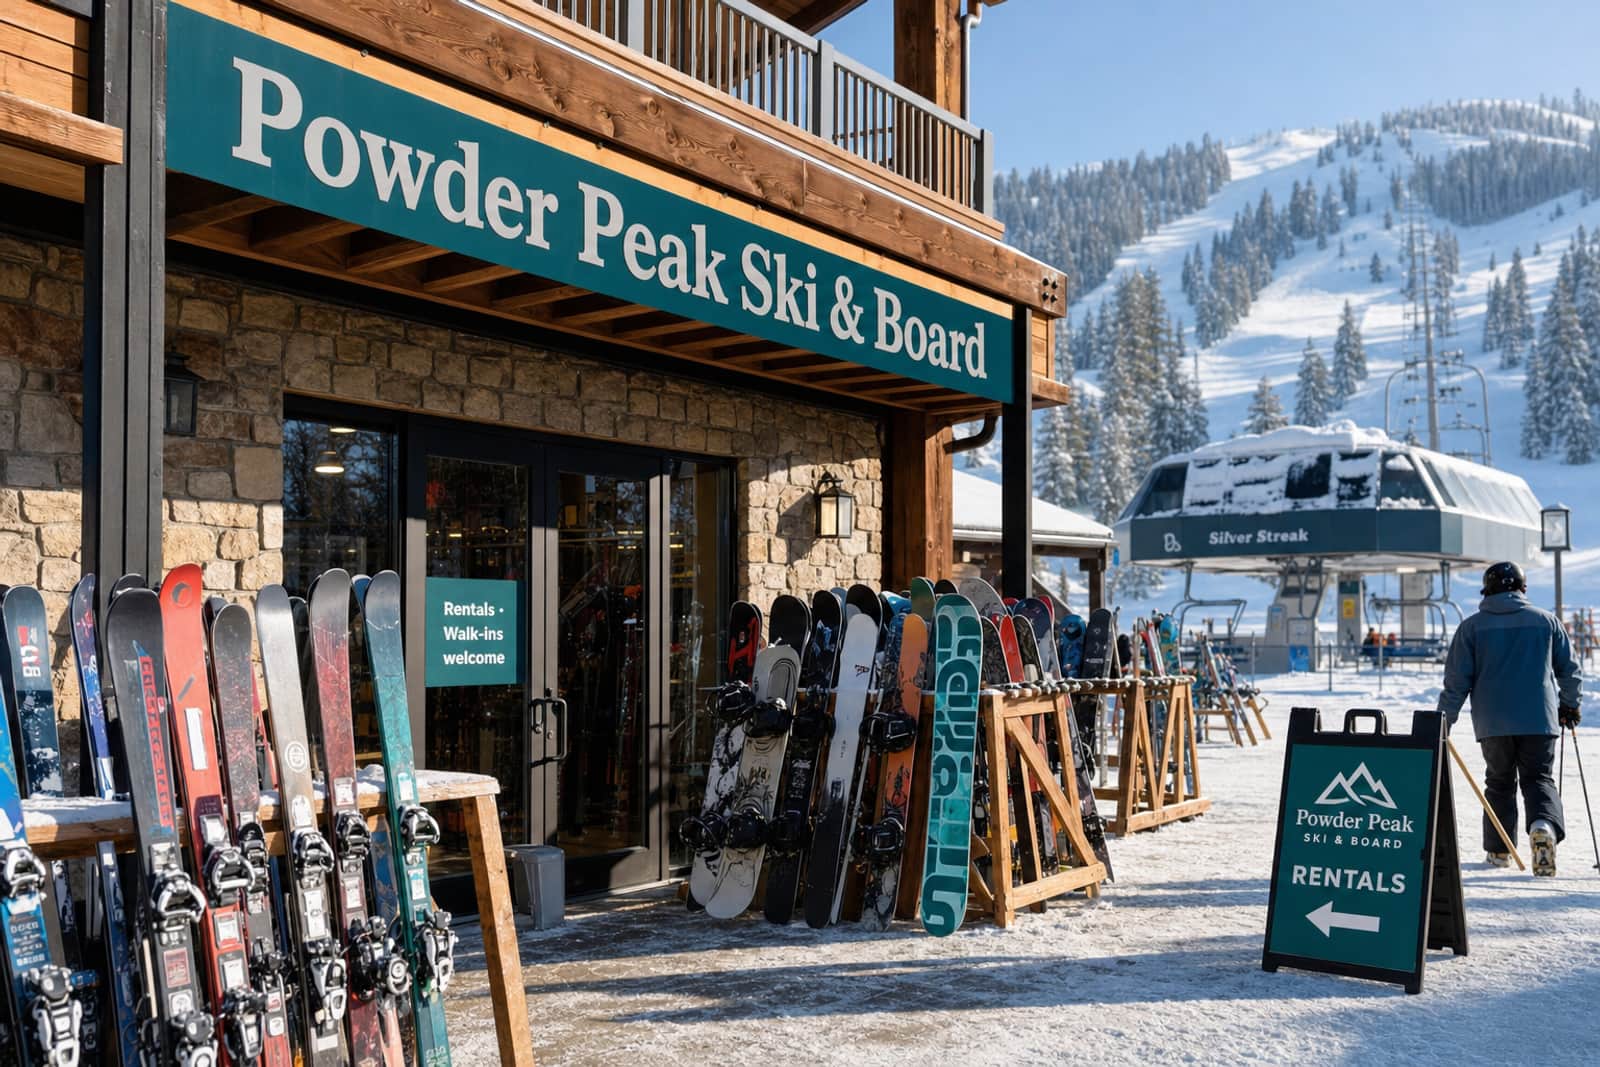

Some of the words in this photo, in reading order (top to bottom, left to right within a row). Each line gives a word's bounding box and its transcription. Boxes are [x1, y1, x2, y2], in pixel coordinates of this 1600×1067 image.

[232, 56, 558, 250] Powder
[578, 181, 728, 305] Peak
[741, 243, 820, 331] Ski
[830, 275, 865, 345] &
[873, 287, 987, 379] Board
[1208, 530, 1252, 545] Silver
[1256, 528, 1309, 543] Streak
[443, 601, 495, 617] Rentals
[443, 626, 504, 641] Walk-ins
[443, 650, 505, 665] welcome
[1295, 808, 1363, 830] Powder
[1367, 813, 1414, 833] Peak
[1303, 833, 1327, 843] SKI
[1334, 835, 1343, 845] &
[1351, 836, 1402, 849] BOARD
[1292, 864, 1407, 894] RENTALS
